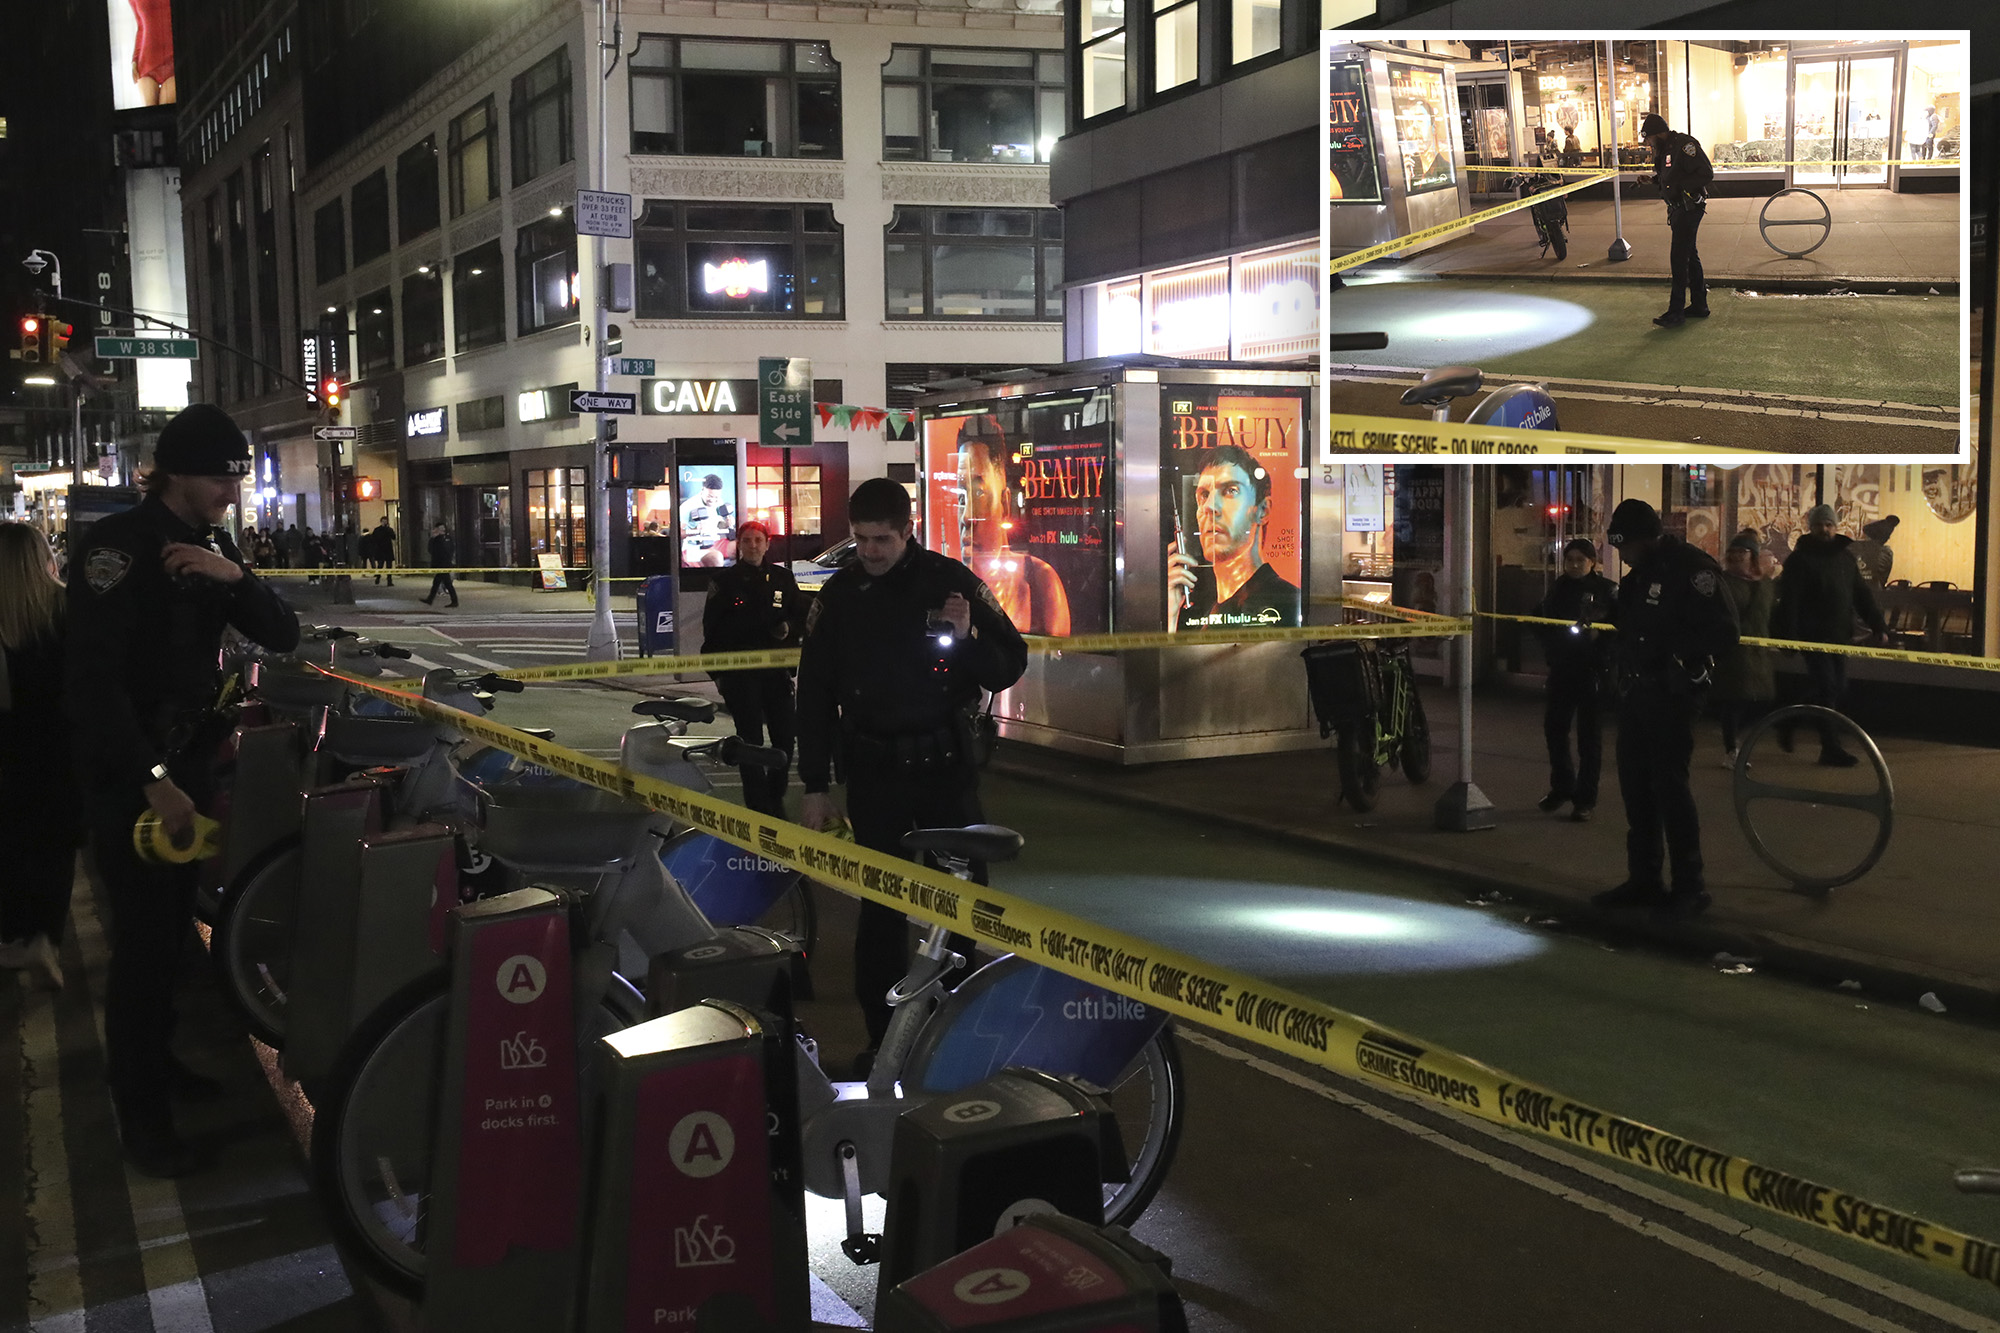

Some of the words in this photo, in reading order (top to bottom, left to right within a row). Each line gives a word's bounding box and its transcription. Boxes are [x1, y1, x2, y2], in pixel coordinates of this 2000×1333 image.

[1538, 76, 1567, 90] BBQ
[596, 196, 625, 205] TRUCKS
[582, 203, 598, 211] OVER
[601, 205, 609, 213] 33
[120, 342, 132, 354] W
[139, 342, 155, 355] 38
[162, 343, 175, 355] St
[303, 338, 317, 382] FITNESS
[622, 361, 629, 372] W
[633, 360, 644, 373] 38
[654, 381, 736, 412] CAVA
[770, 391, 801, 403] East
[1218, 388, 1255, 396] JCDecaux
[580, 398, 599, 407] ONE
[608, 398, 627, 408] WAY
[1177, 403, 1188, 412] FX
[770, 408, 802, 419] Side
[1179, 415, 1293, 450] BEAUTY
[1023, 446, 1031, 455] FX
[1024, 456, 1106, 499] BEAUTY
[1407, 486, 1442, 498] HAPPY
[1410, 499, 1441, 511] HOUR
[1046, 531, 1057, 543] FX
[1060, 531, 1078, 544] hulu
[1186, 617, 1200, 626] Jan
[1200, 617, 1209, 625] 21
[1209, 614, 1223, 624] FX
[1228, 613, 1251, 624] hulu
[862, 863, 884, 892] CRIME
[883, 870, 904, 900] SCENE
[918, 882, 935, 911] NOT
[933, 888, 960, 920] CROSS
[507, 963, 537, 993] A
[1040, 927, 1113, 977] 1-800-577-TIPS
[1149, 962, 1184, 1002] CRIME
[1185, 974, 1229, 1016] SCENE
[1236, 991, 1258, 1026] DO
[1255, 997, 1286, 1036] NOT
[1283, 1006, 1336, 1052] CROSS
[485, 1098, 518, 1111] Park
[522, 1096, 535, 1108] in
[481, 1117, 524, 1130] docks
[527, 1114, 559, 1127] first.
[683, 1122, 723, 1164] A
[1498, 1083, 1655, 1166] 1-800-577-TIPS
[1743, 1164, 1829, 1227] CRIME
[1832, 1194, 1929, 1260] SCENE
[654, 1307, 697, 1325] Park
